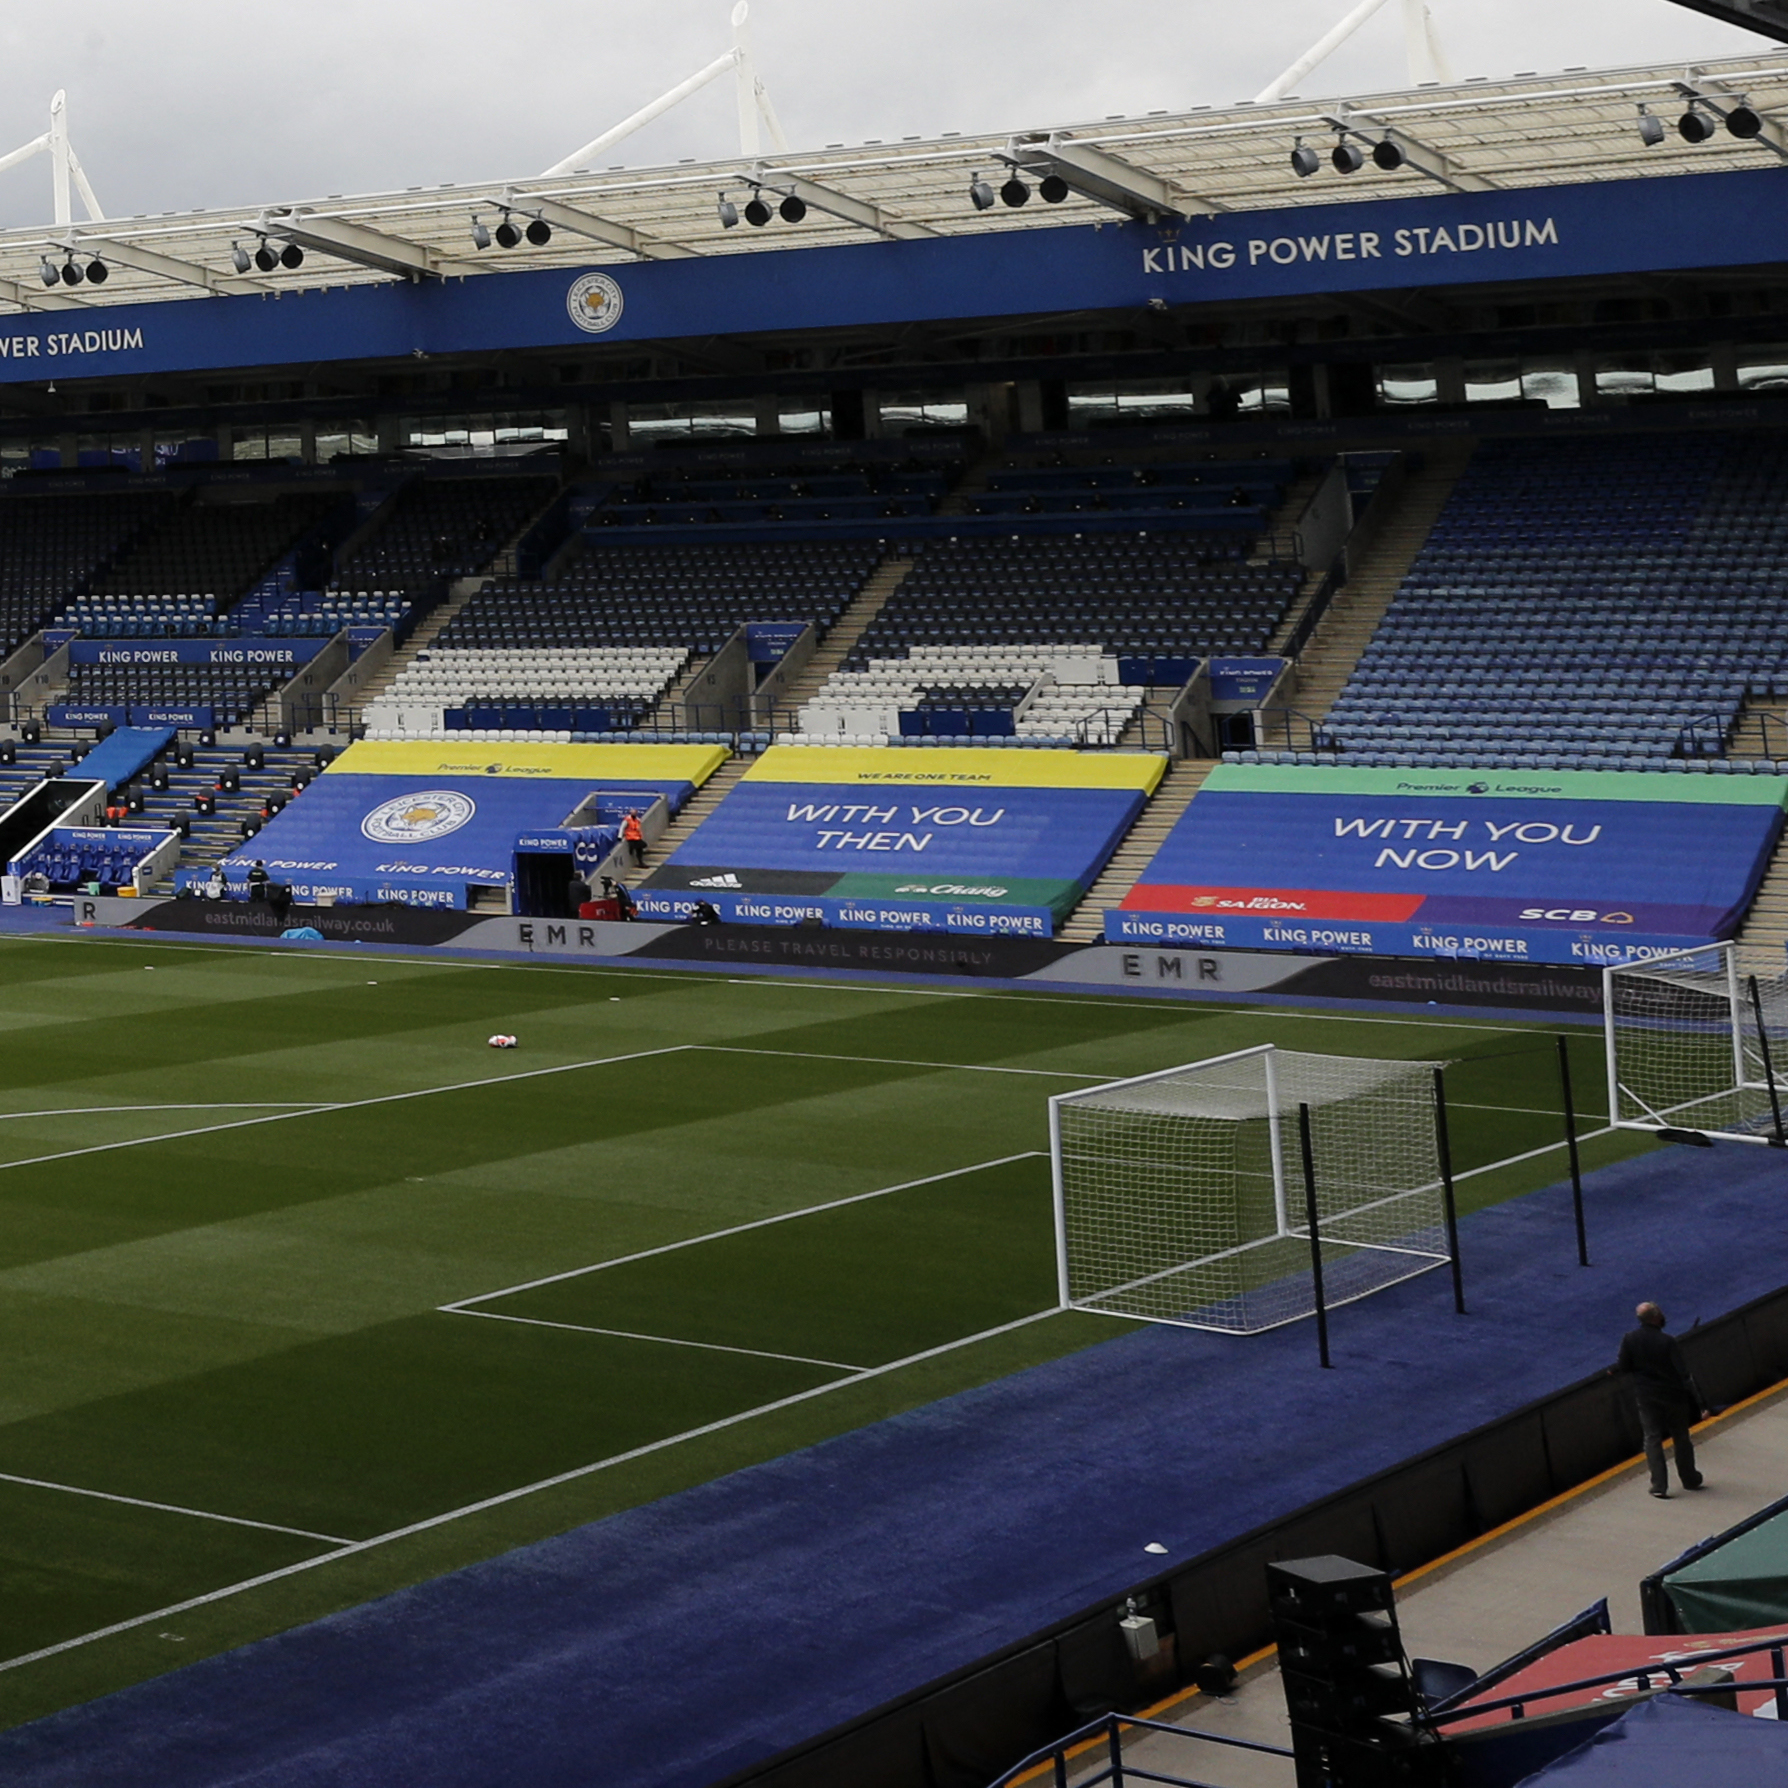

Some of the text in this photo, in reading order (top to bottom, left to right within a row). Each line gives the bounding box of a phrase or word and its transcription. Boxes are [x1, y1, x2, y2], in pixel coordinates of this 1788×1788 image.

[1141, 217, 1558, 274] KING POWER STADIUM
[47, 328, 144, 356] STADIUM
[99, 650, 178, 663] KING POWER
[210, 650, 293, 662] KING POWER
[148, 713, 193, 722] KING POWER
[436, 763, 553, 775] Premier League
[1396, 782, 1563, 793] Premier League
[786, 803, 1005, 826] WITH YOU
[1334, 817, 1602, 845] WITH YOU
[519, 838, 568, 847] KING POWER
[816, 830, 933, 851] THEN
[1374, 848, 1519, 872] NOW
[375, 863, 505, 881] KING POWER
[377, 888, 454, 903] KING POWER
[929, 884, 1008, 898] Chang
[82, 902, 96, 920] R
[735, 904, 824, 920] KING POWER
[839, 908, 932, 926] KING POWER
[1518, 909, 1598, 921] SCB
[947, 913, 1043, 931] KING POWER
[1122, 922, 1225, 938] KING POWER
[519, 924, 595, 946] EMR
[1263, 927, 1372, 945] KING POWER
[1412, 935, 1527, 953] KING POWER
[705, 938, 773, 953] PLEASE
[780, 941, 851, 957] TRAVEL
[1122, 954, 1223, 980] EMR
